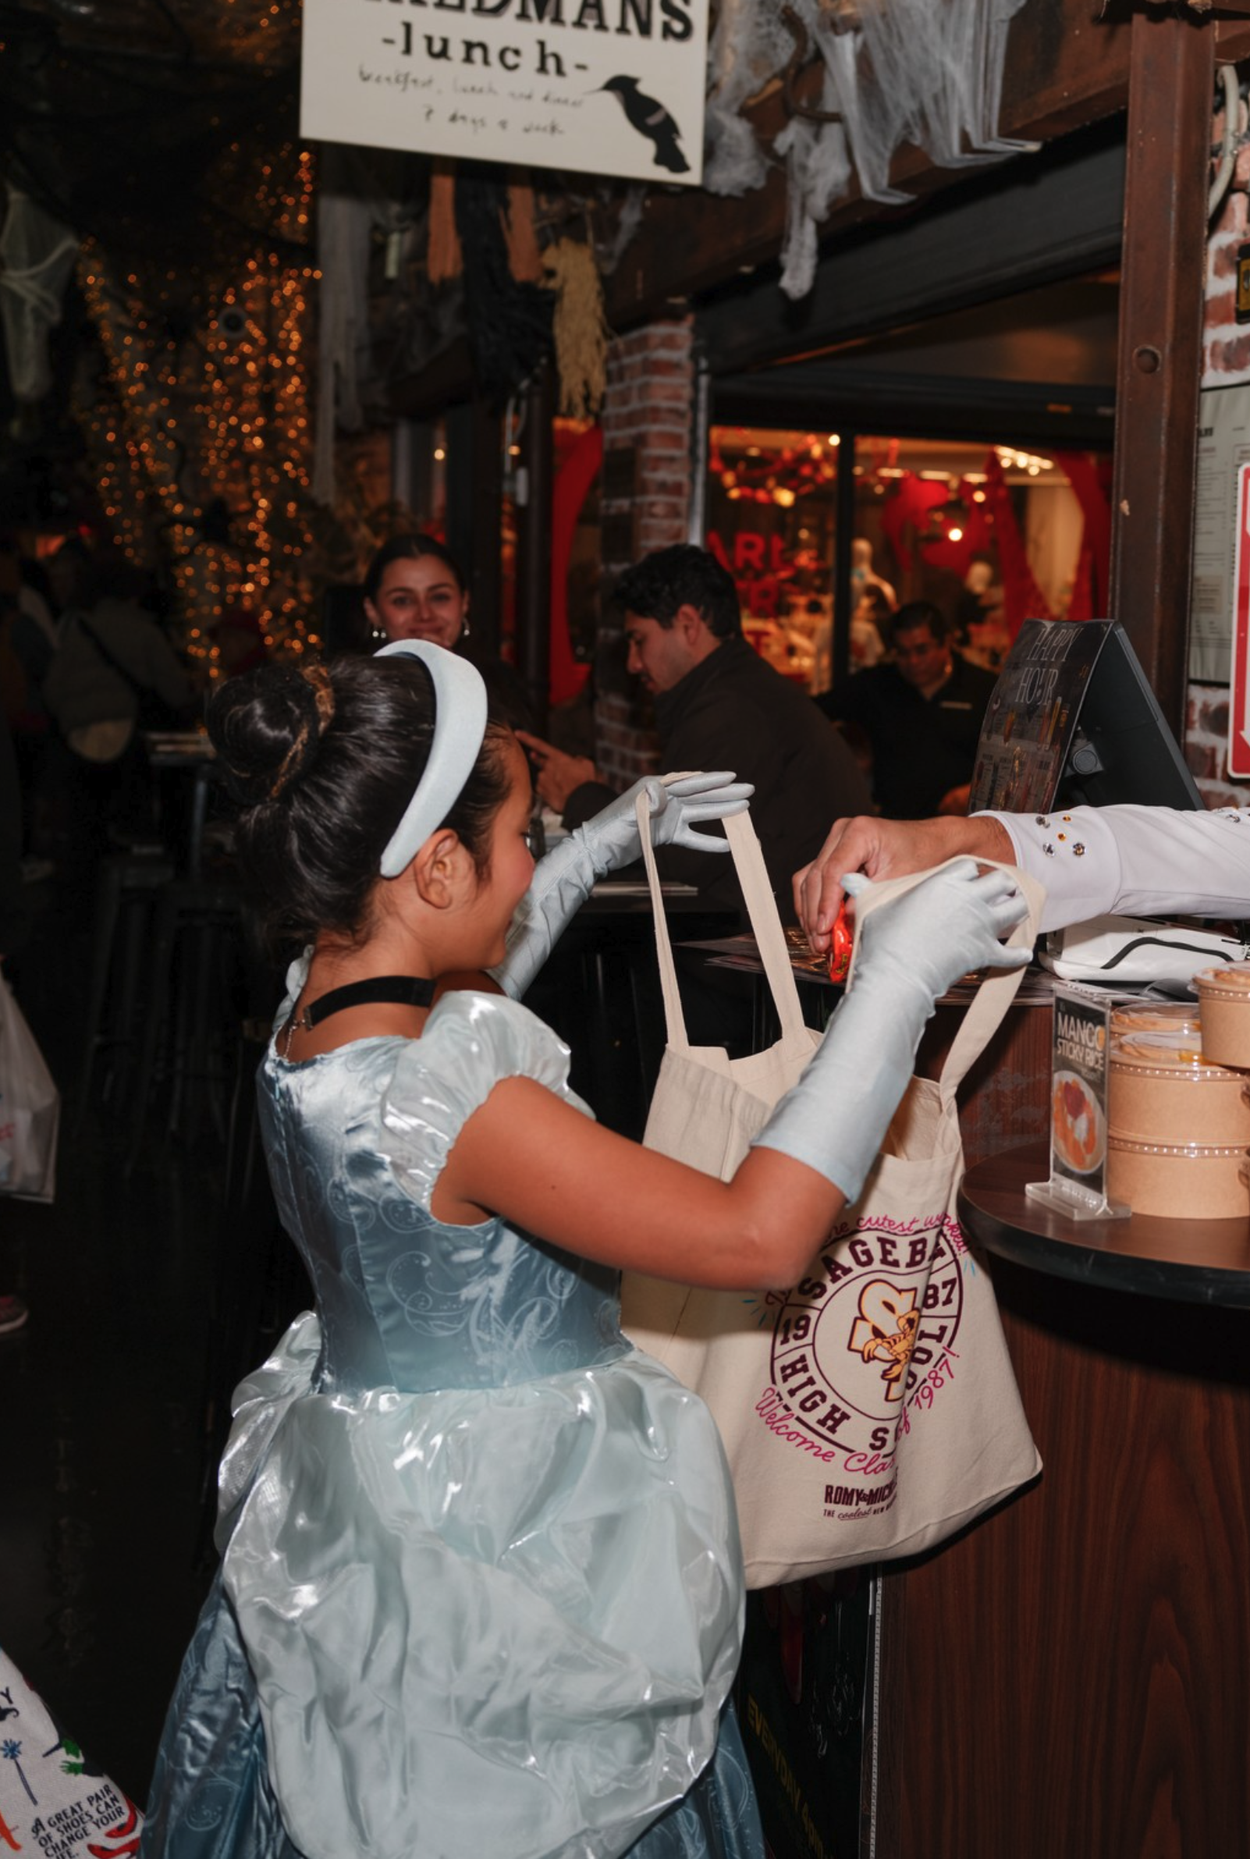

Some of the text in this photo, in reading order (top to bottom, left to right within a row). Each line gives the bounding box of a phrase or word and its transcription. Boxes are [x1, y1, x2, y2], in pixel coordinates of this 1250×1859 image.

[1026, 627, 1084, 662] HAPPY
[1057, 1011, 1105, 1052] MANGO
[1057, 1038, 1104, 1071] STICKY RICE
[923, 1277, 957, 1309] 87
[780, 1314, 812, 1345] 19
[780, 1353, 851, 1435] HIGH
[755, 1387, 836, 1462] Welcome
[823, 1509, 835, 1518] THE
[38, 1794, 120, 1848] OF SHOES CAN
[47, 1802, 84, 1828] GREAT
[86, 1784, 113, 1806] PAIR
[44, 1806, 125, 1857] CHANGE YOUR
